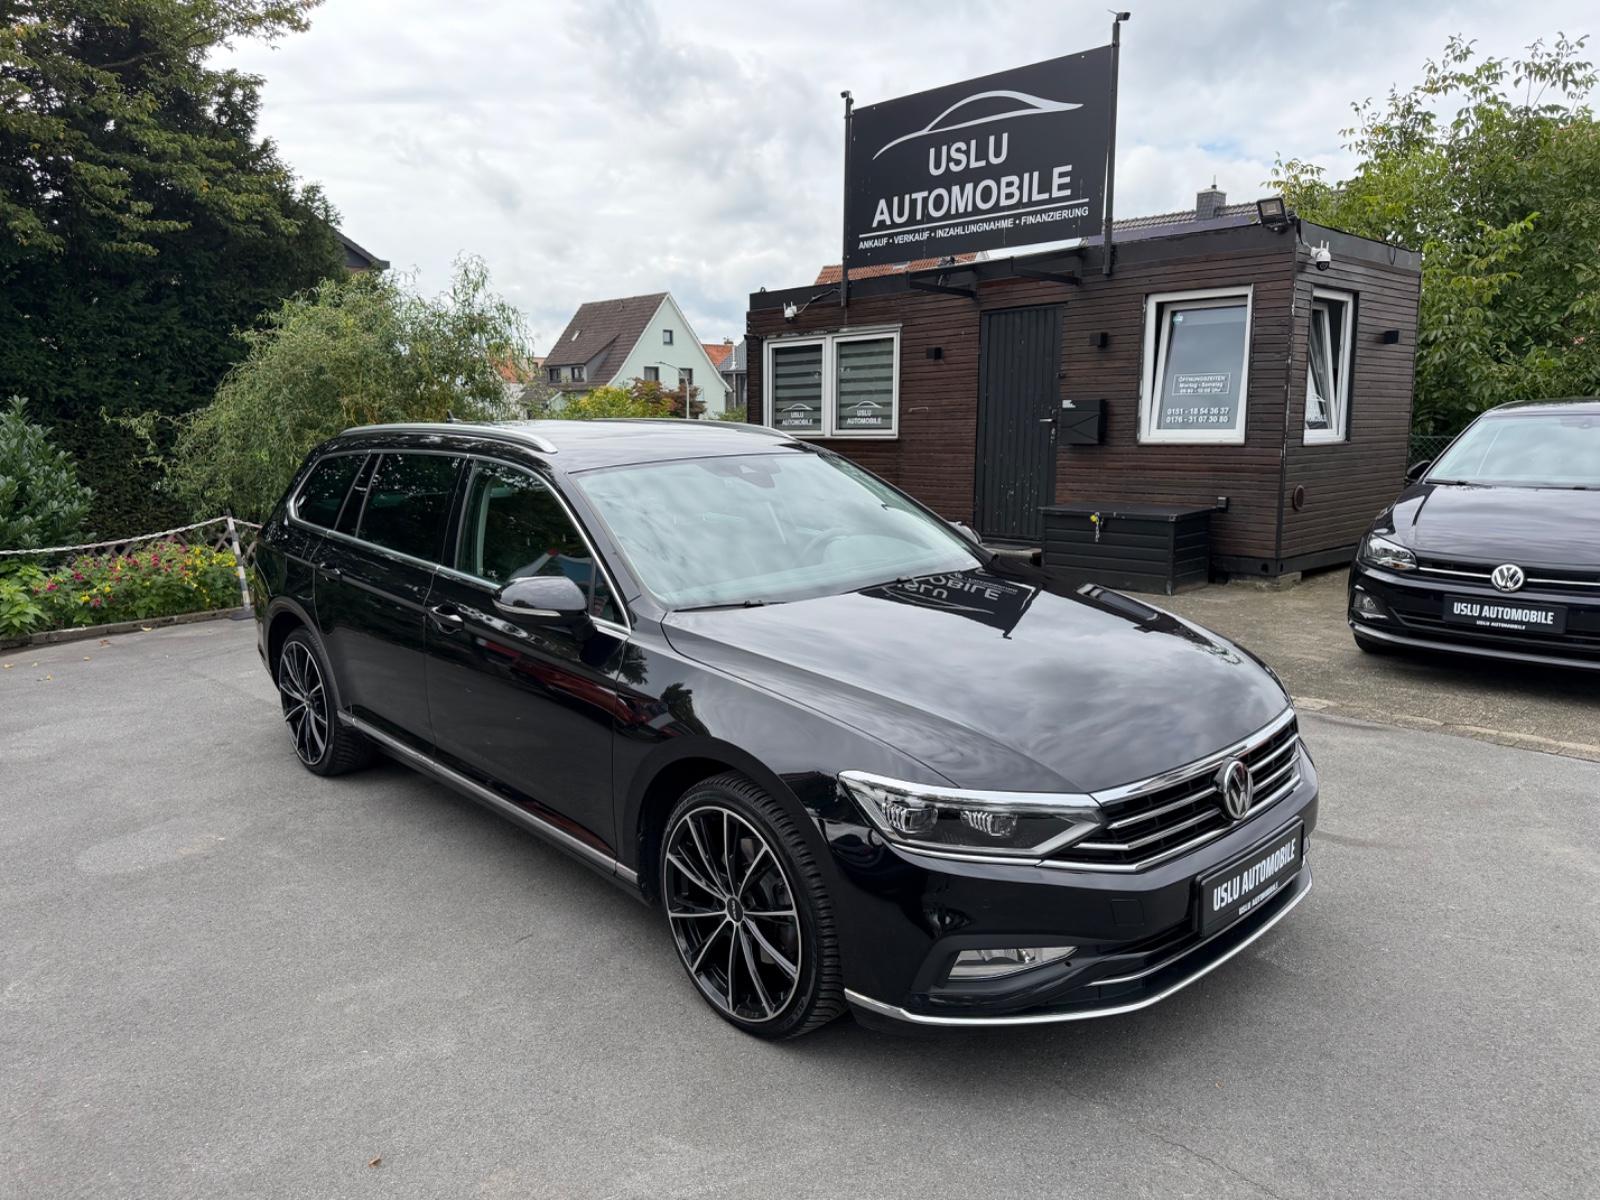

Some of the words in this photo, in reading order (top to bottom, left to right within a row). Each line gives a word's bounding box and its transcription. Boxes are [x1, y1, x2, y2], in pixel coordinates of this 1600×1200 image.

[929, 132, 1008, 176] USLU
[872, 165, 1073, 227] AUTOMOBILE
[858, 237, 889, 250] ANKAUF
[893, 230, 931, 245] VERKAUF
[936, 218, 1014, 238] INZAHLUNGNAHME
[1021, 206, 1089, 226] FINANZIERUNG
[782, 418, 813, 426] AUTOMOBILE
[846, 416, 882, 425] AUTOMOBILE
[1198, 415, 1208, 423] 07
[1453, 602, 1481, 616] USLU
[1481, 603, 1554, 625] AUTOMOBILE
[1490, 621, 1526, 630] AUTOMOBILE
[1213, 874, 1241, 912] USLU
[1241, 838, 1296, 896] AUTOMOBILE
[1238, 899, 1251, 915] USLU
[1251, 881, 1279, 909] AUTOMOBILE
